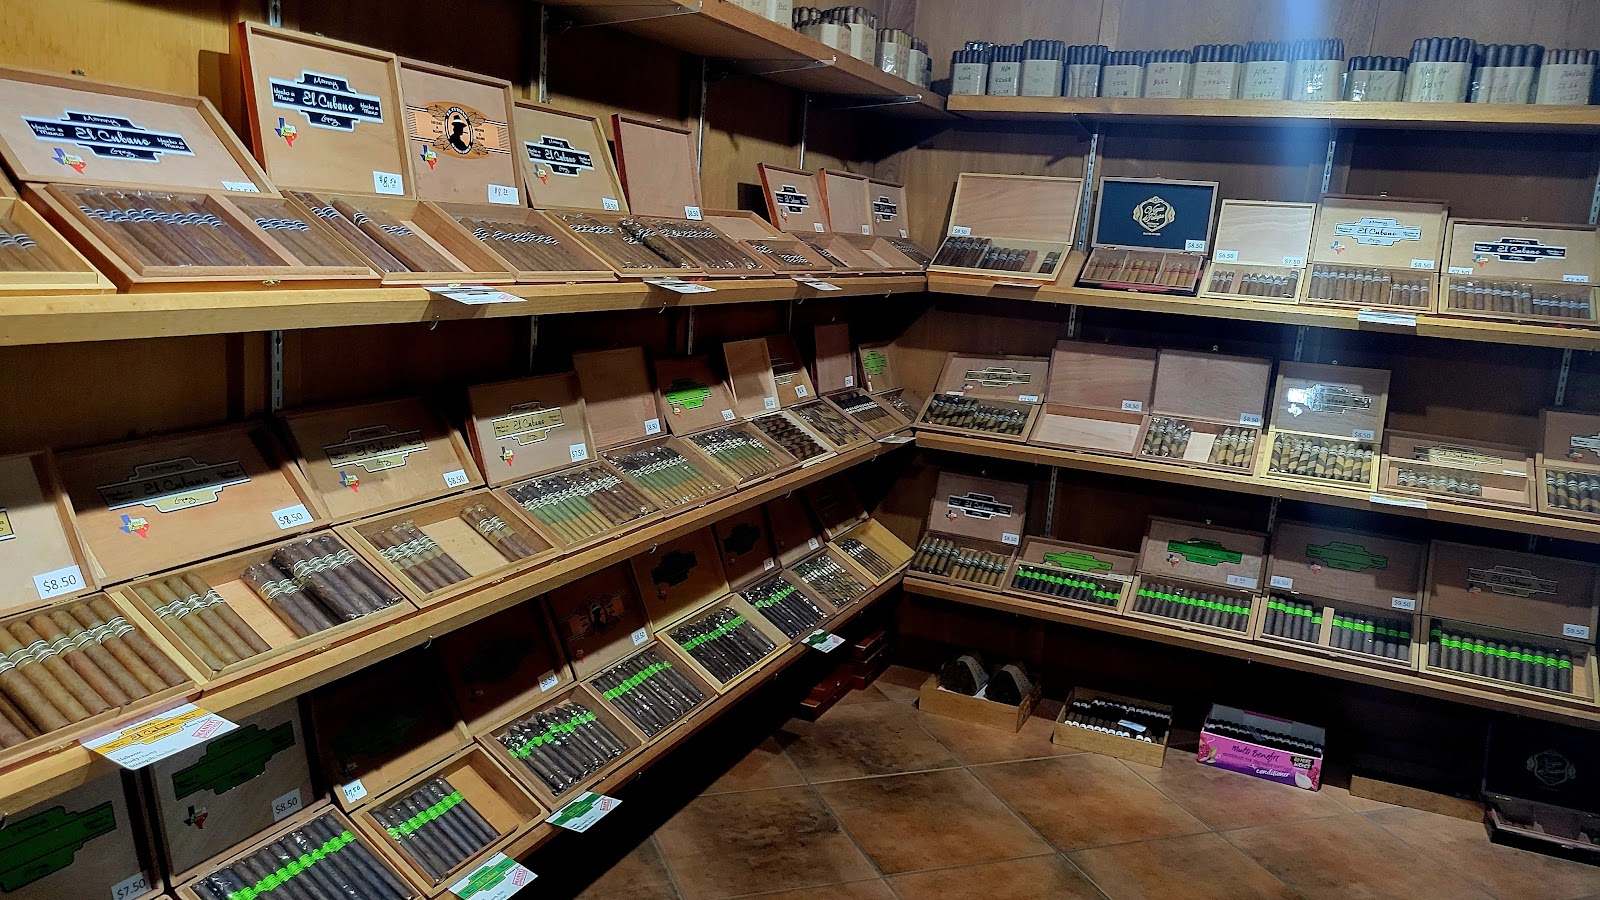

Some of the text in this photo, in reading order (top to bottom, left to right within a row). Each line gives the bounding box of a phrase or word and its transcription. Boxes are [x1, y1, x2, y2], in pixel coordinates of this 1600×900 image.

[314, 77, 339, 90] Manny
[274, 88, 290, 96] Hecho
[275, 94, 294, 102] Mano
[303, 91, 355, 112] El Cubano
[360, 102, 373, 110] Hecho
[83, 114, 120, 126] Manny
[75, 127, 151, 146] El Cubano
[544, 149, 576, 163] El Cubano
[1368, 228, 1397, 237] Cubano
[514, 417, 545, 430] El Cubano
[646, 424, 658, 432] $8.50
[355, 442, 400, 456] El Cubano
[572, 449, 585, 458] $7.50
[144, 477, 211, 494] El Cubano
[448, 475, 466, 486] $8.50
[278, 512, 304, 524] $8.50
[43, 574, 78, 593] $8.50
[144, 722, 176, 734] Cubano
[1232, 744, 1250, 755] Multi
[1252, 750, 1280, 762] Benefit
[276, 797, 298, 814] $8.50
[118, 878, 146, 900] $7.50
